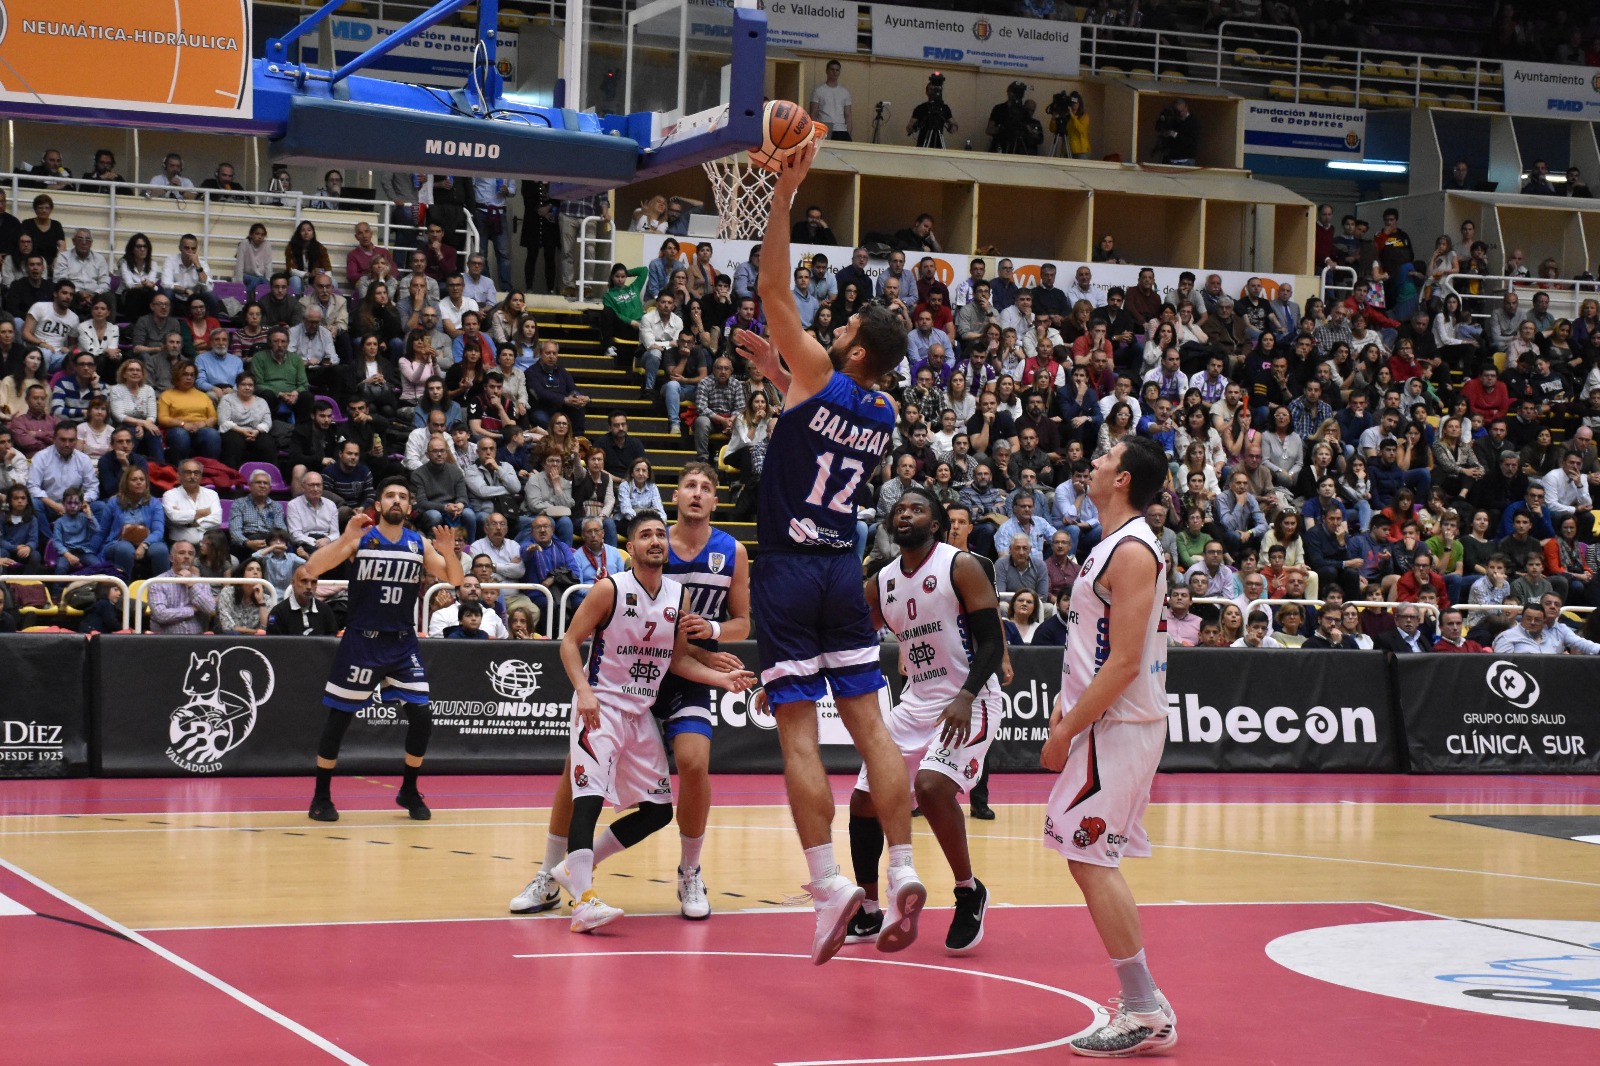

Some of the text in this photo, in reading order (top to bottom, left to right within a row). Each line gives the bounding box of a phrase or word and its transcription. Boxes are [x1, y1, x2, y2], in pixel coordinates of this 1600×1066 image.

[772, 4, 845, 19] de Valladolid
[22, 19, 238, 51] NEUMÁTICA-HIDRÁULICA
[884, 14, 1069, 43] Ayuntamiento de Valladolid
[923, 45, 964, 61] FMD
[1513, 70, 1585, 86] Ayuntamiento
[1547, 98, 1584, 112] FMD
[1250, 106, 1364, 122] Fundación Municipal
[1270, 116, 1344, 129] de Deportes
[425, 139, 500, 159] MONDO
[805, 451, 865, 514] 12
[380, 586, 403, 605] 30
[907, 597, 918, 621] 0
[642, 621, 658, 642] 7
[347, 665, 373, 685] 30
[431, 719, 470, 727] ECNICAS
[473, 719, 484, 727] DE
[487, 719, 527, 728] FIJACION
[530, 720, 537, 728] Y
[1463, 713, 1566, 725] GRUPO CMD SALUD
[459, 727, 570, 737] SUMINISTRO INDUSTRIAL
[1014, 727, 1028, 741] DE
[1446, 729, 1586, 755] CLÍNICA SUR
[38, 751, 63, 761] 1925
[165, 746, 223, 773] VALLADOLID
